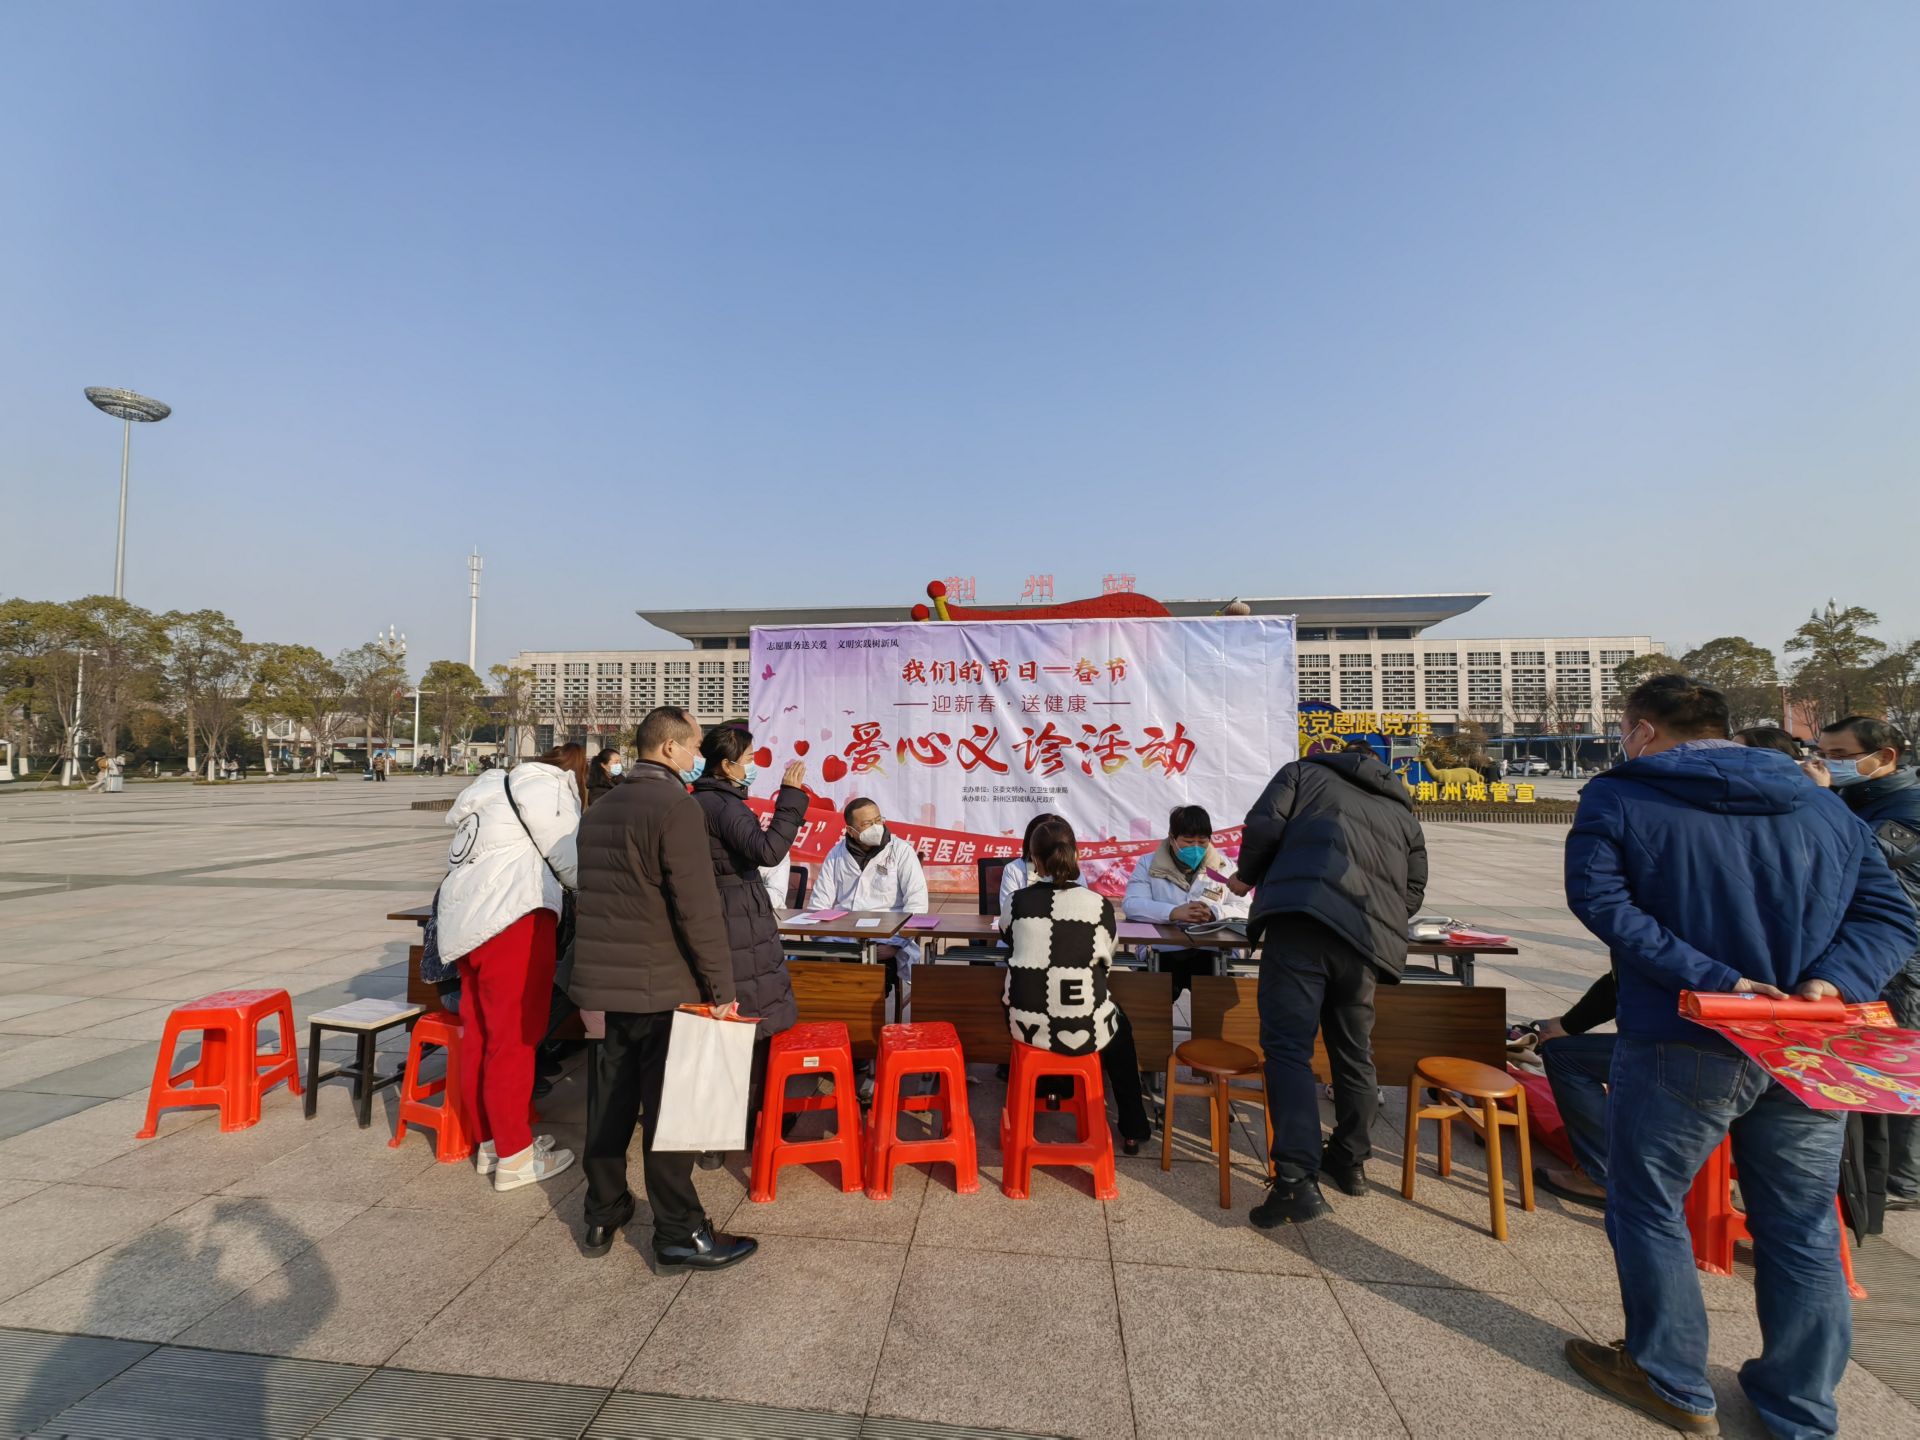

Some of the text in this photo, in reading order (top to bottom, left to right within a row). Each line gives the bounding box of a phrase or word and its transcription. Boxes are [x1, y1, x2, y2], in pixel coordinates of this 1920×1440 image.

[944, 573, 1137, 600] 荆州站
[766, 638, 899, 651] 志愿服务送关爱 文明实践树新风
[843, 721, 1197, 778] 爱心义诊活动
[1416, 780, 1536, 803] 荆州城管宣
[1060, 979, 1085, 1006] E
[1015, 1020, 1041, 1044] Y
